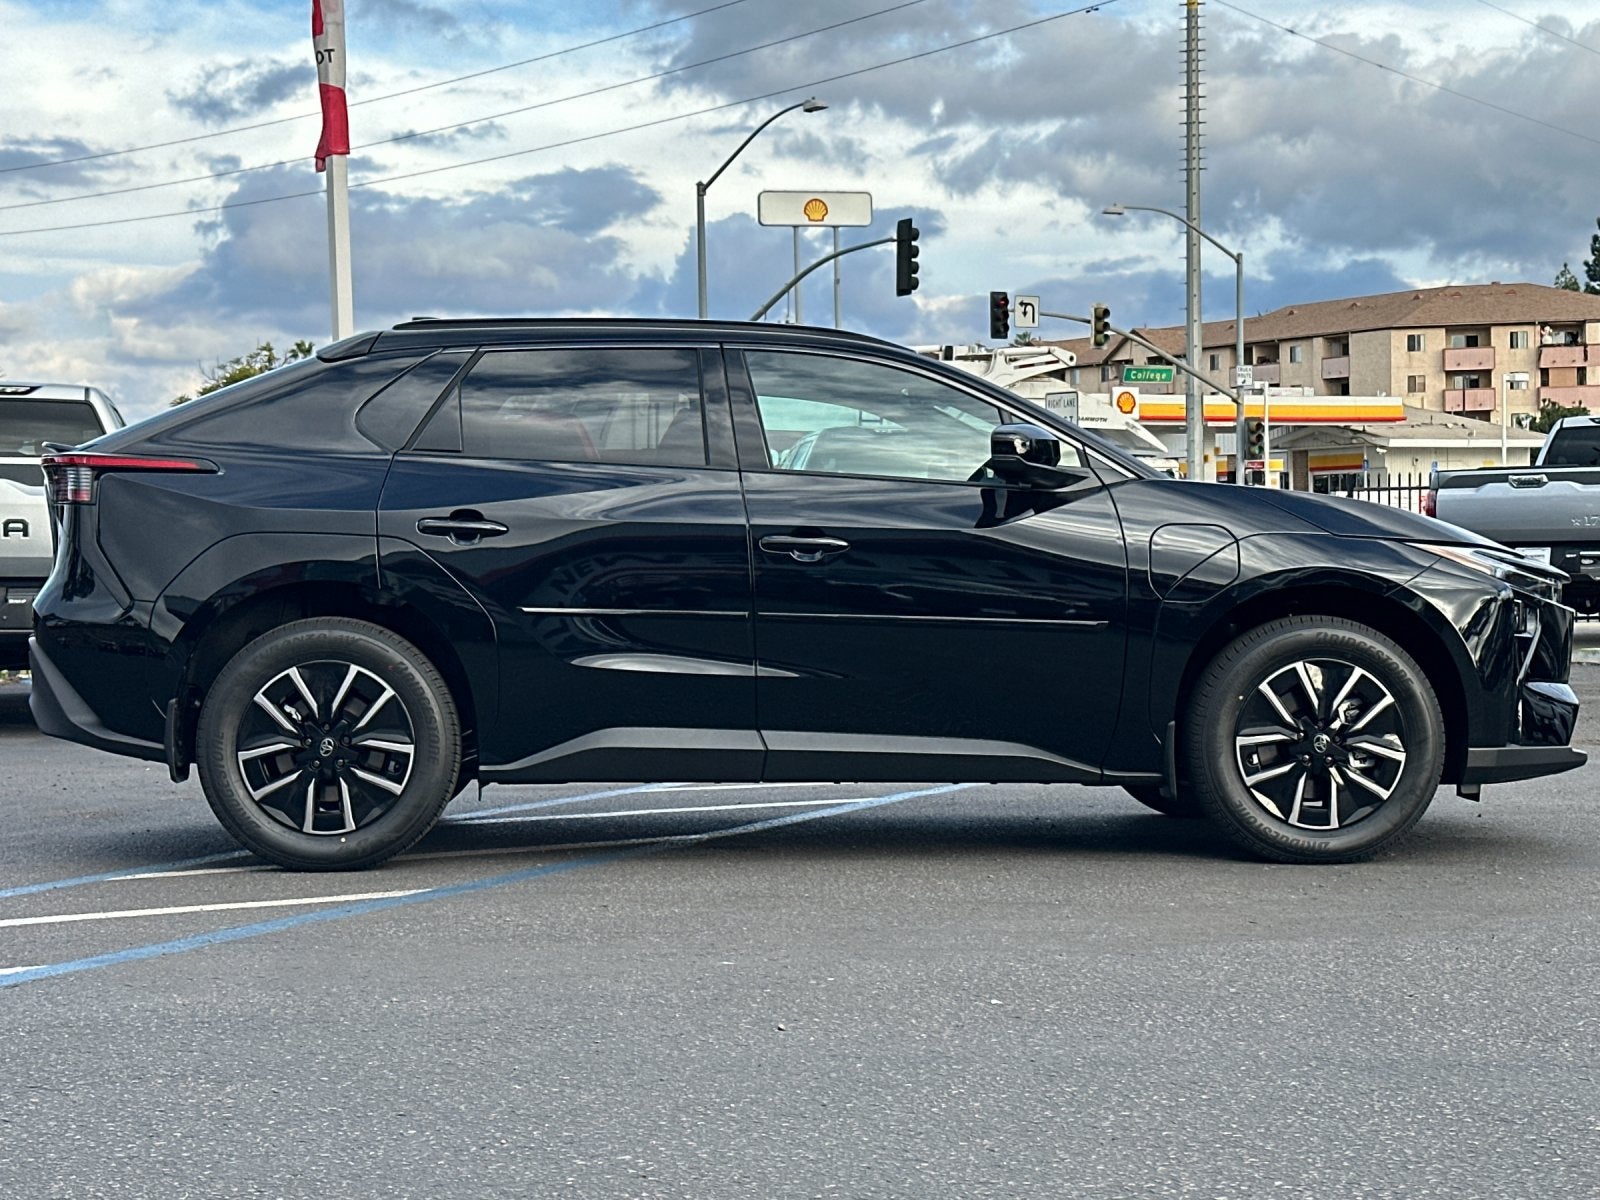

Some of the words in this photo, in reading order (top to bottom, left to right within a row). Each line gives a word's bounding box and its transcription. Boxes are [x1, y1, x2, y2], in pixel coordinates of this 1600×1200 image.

[1130, 370, 1167, 381] College
[1047, 398, 1061, 409] RIGHT
[1063, 398, 1076, 408] LANE
[1315, 631, 1415, 686] BRIDGESTONE
[396, 660, 441, 765] BRIDGESTONE
